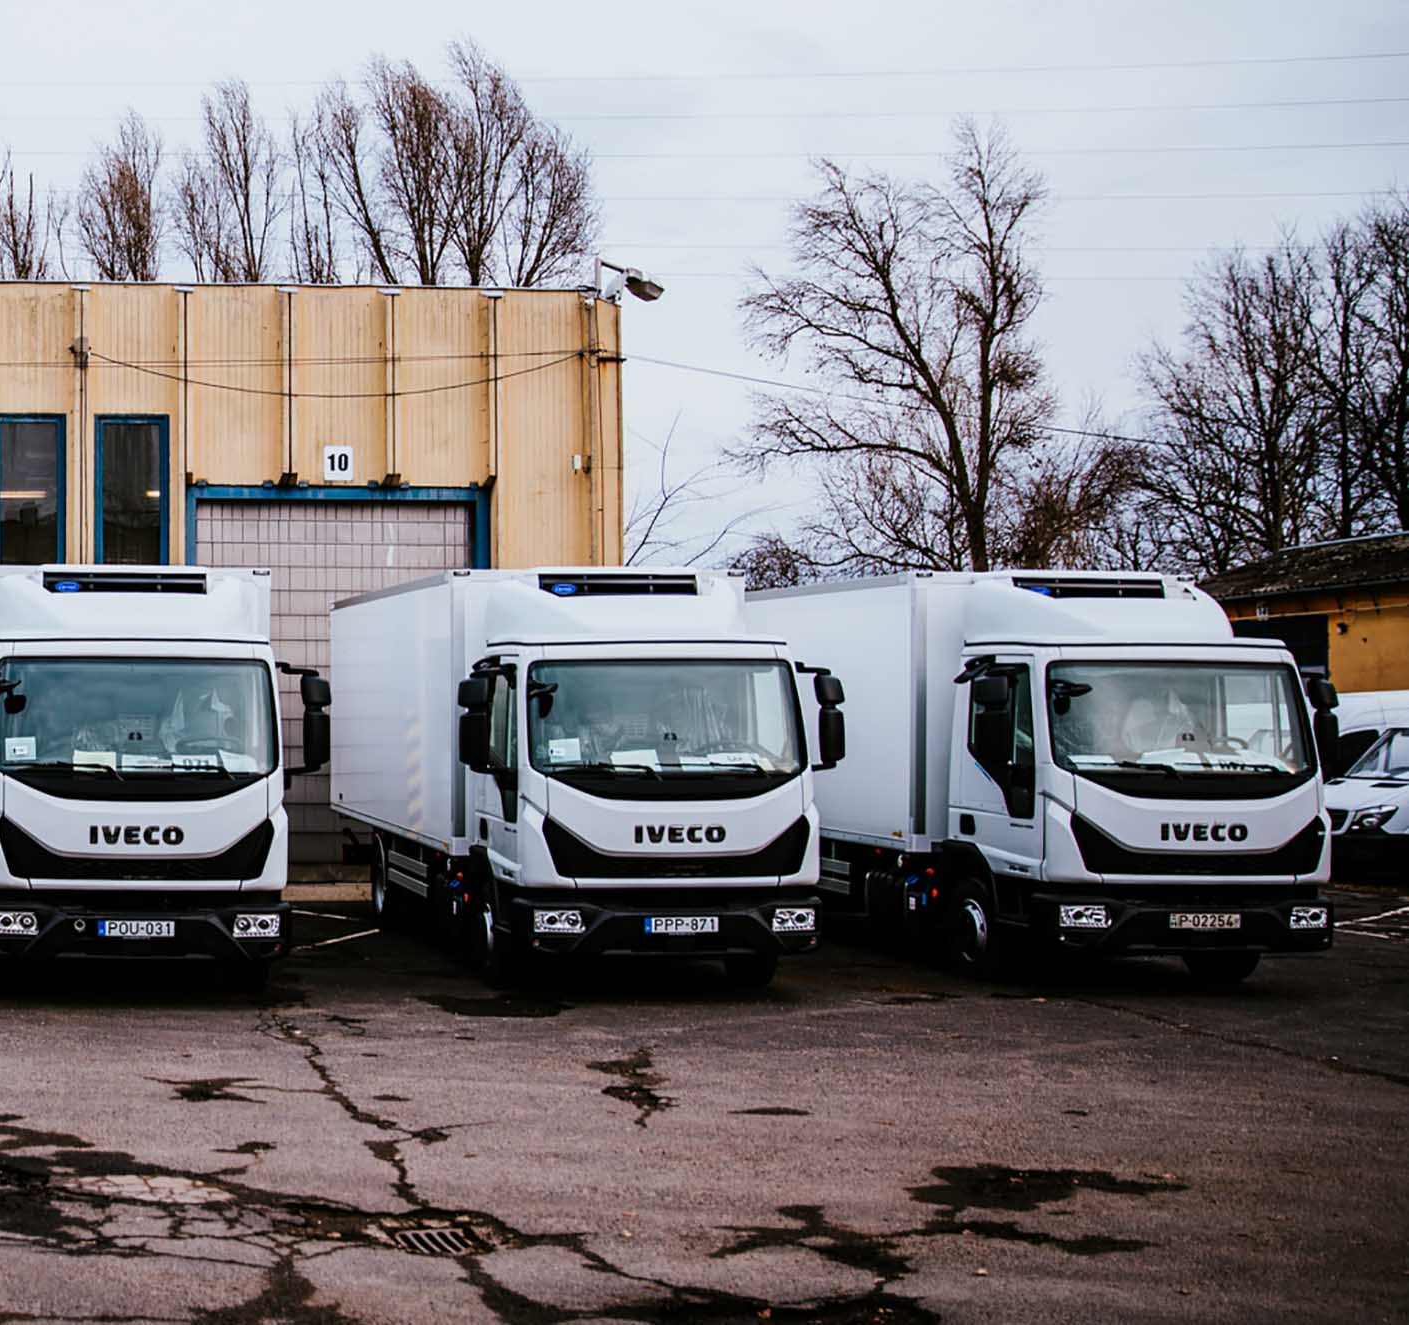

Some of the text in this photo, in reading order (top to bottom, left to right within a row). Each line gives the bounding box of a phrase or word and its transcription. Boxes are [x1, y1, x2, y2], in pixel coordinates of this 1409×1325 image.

[327, 453, 349, 471] 10
[89, 825, 185, 846] IVECO
[634, 825, 726, 844] IVECO
[1160, 823, 1248, 842] IVECO
[108, 922, 170, 935] POU-031
[654, 918, 715, 931] PPP-871
